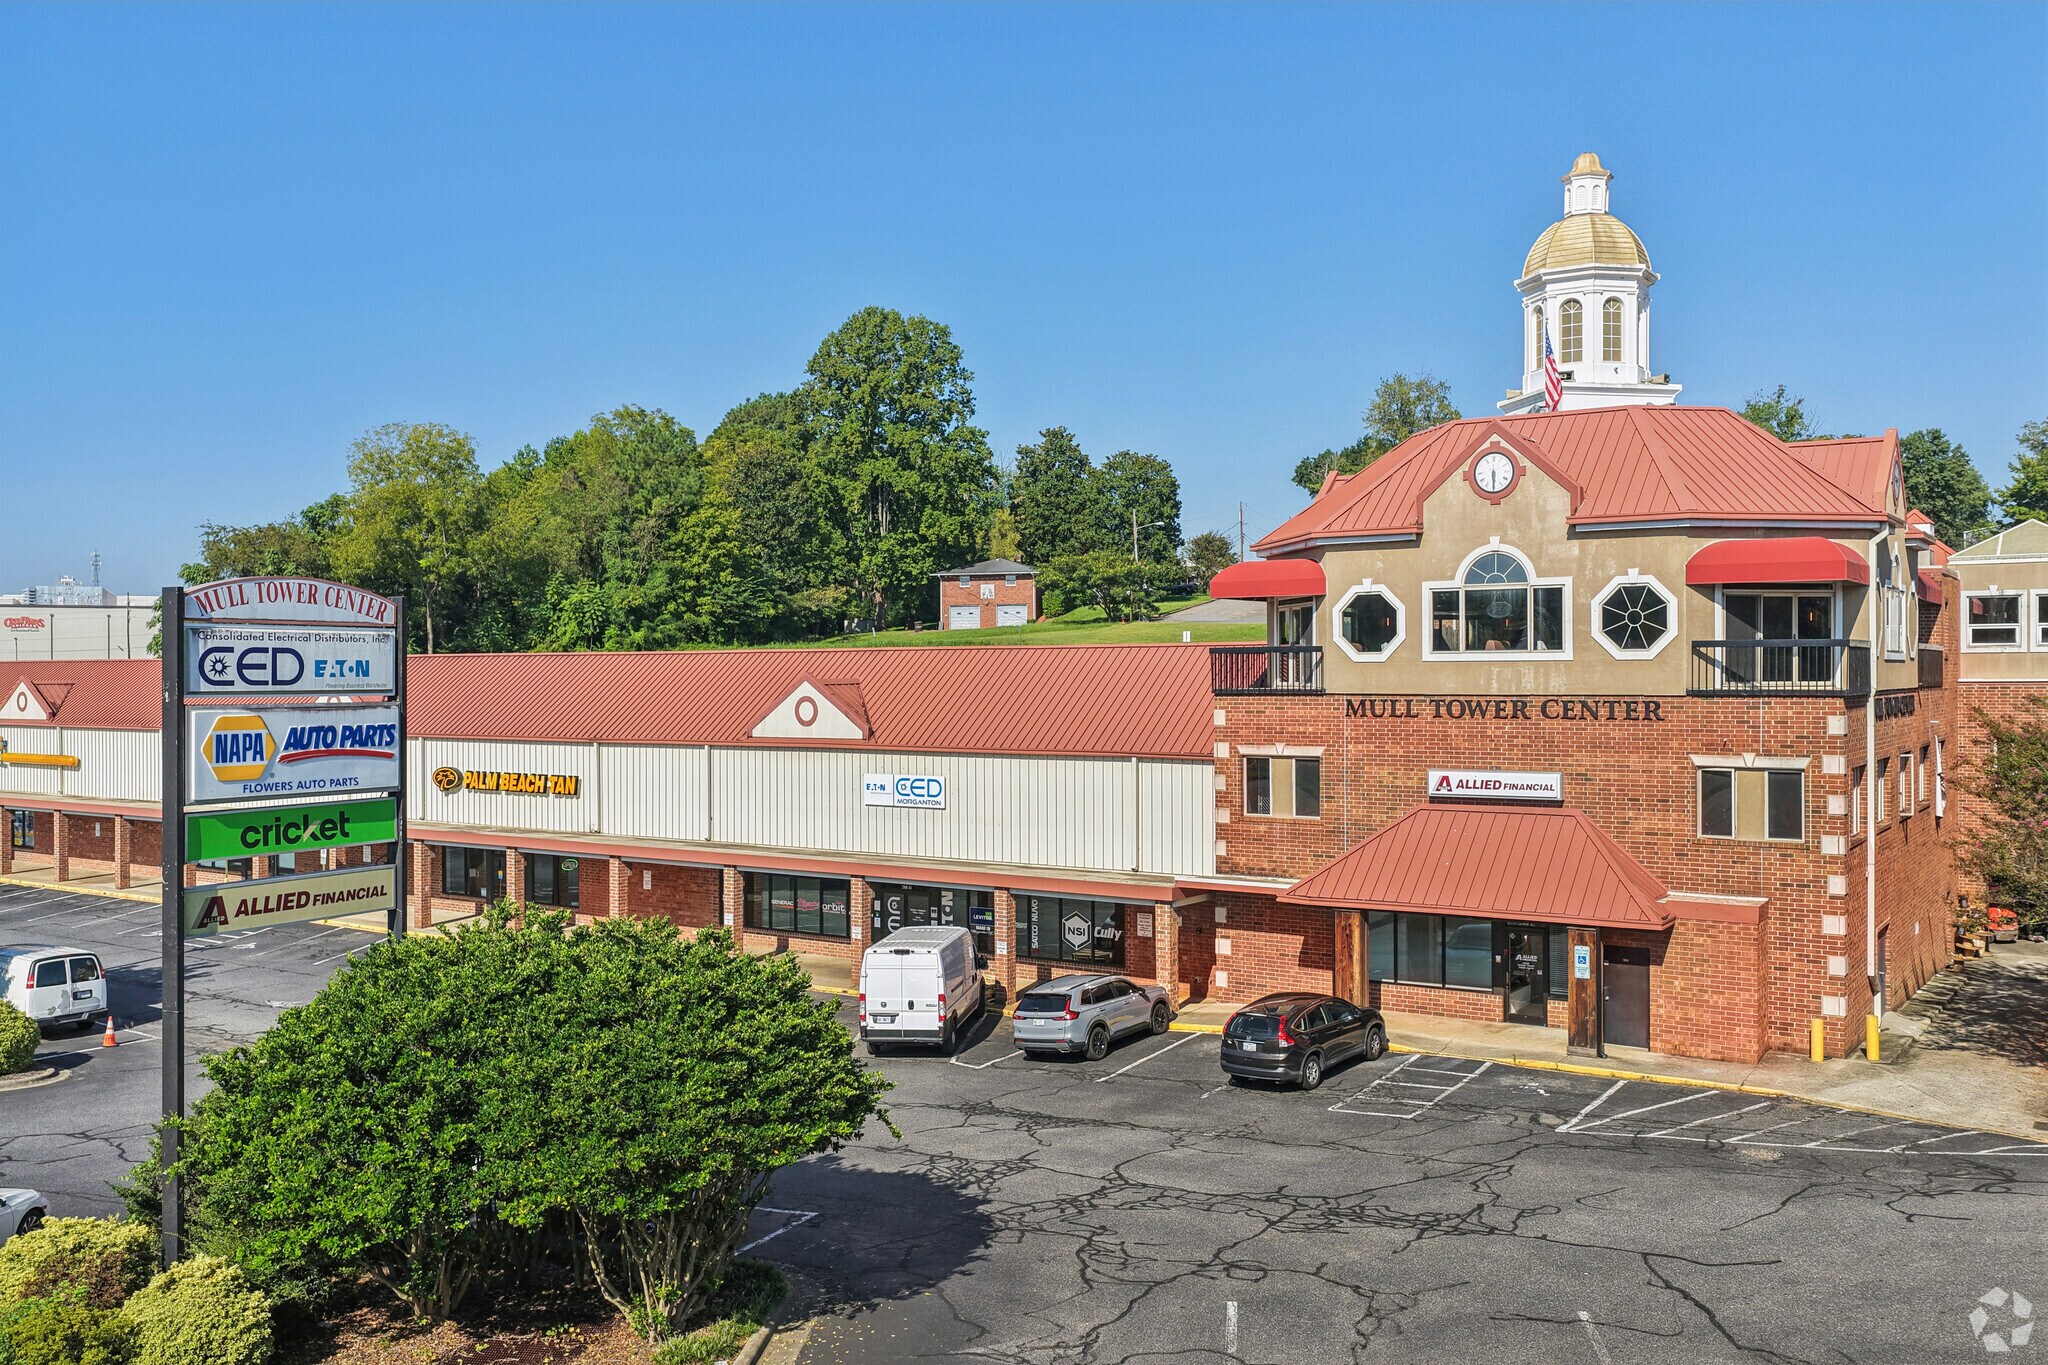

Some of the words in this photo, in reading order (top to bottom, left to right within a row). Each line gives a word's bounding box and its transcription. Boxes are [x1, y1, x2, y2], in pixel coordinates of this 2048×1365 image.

[193, 583, 249, 617] MULL
[254, 581, 319, 605] TOWER
[324, 586, 388, 622] CENTER
[197, 630, 264, 642] Consolidated
[267, 631, 312, 643] Electrical
[314, 633, 369, 644] Distributors,
[372, 635, 388, 644] Inc.
[198, 646, 305, 686] CED
[1344, 698, 1420, 718] MULL
[1428, 698, 1531, 720] TOWER
[1540, 699, 1665, 721] CENTER
[215, 732, 265, 764] NAPA
[282, 725, 338, 751] AUTO
[339, 723, 396, 749] PARTS
[242, 781, 293, 794] FLOWERS
[296, 779, 326, 791] AUTO
[329, 777, 359, 788] PARTS
[463, 771, 499, 791] PALM
[500, 772, 547, 793] BEACH
[550, 775, 579, 796] TAN
[896, 777, 942, 798] CED
[1455, 779, 1502, 791] ALLIED
[1503, 782, 1556, 792] FINANCIAL
[897, 798, 942, 806] MORGANTON
[240, 811, 350, 849] cricket
[234, 890, 311, 918] ALLIED
[312, 885, 388, 907] FINANCIAL
[1031, 899, 1039, 922] NUVO
[1067, 926, 1086, 937] NSI
[1094, 926, 1122, 942] Cully
